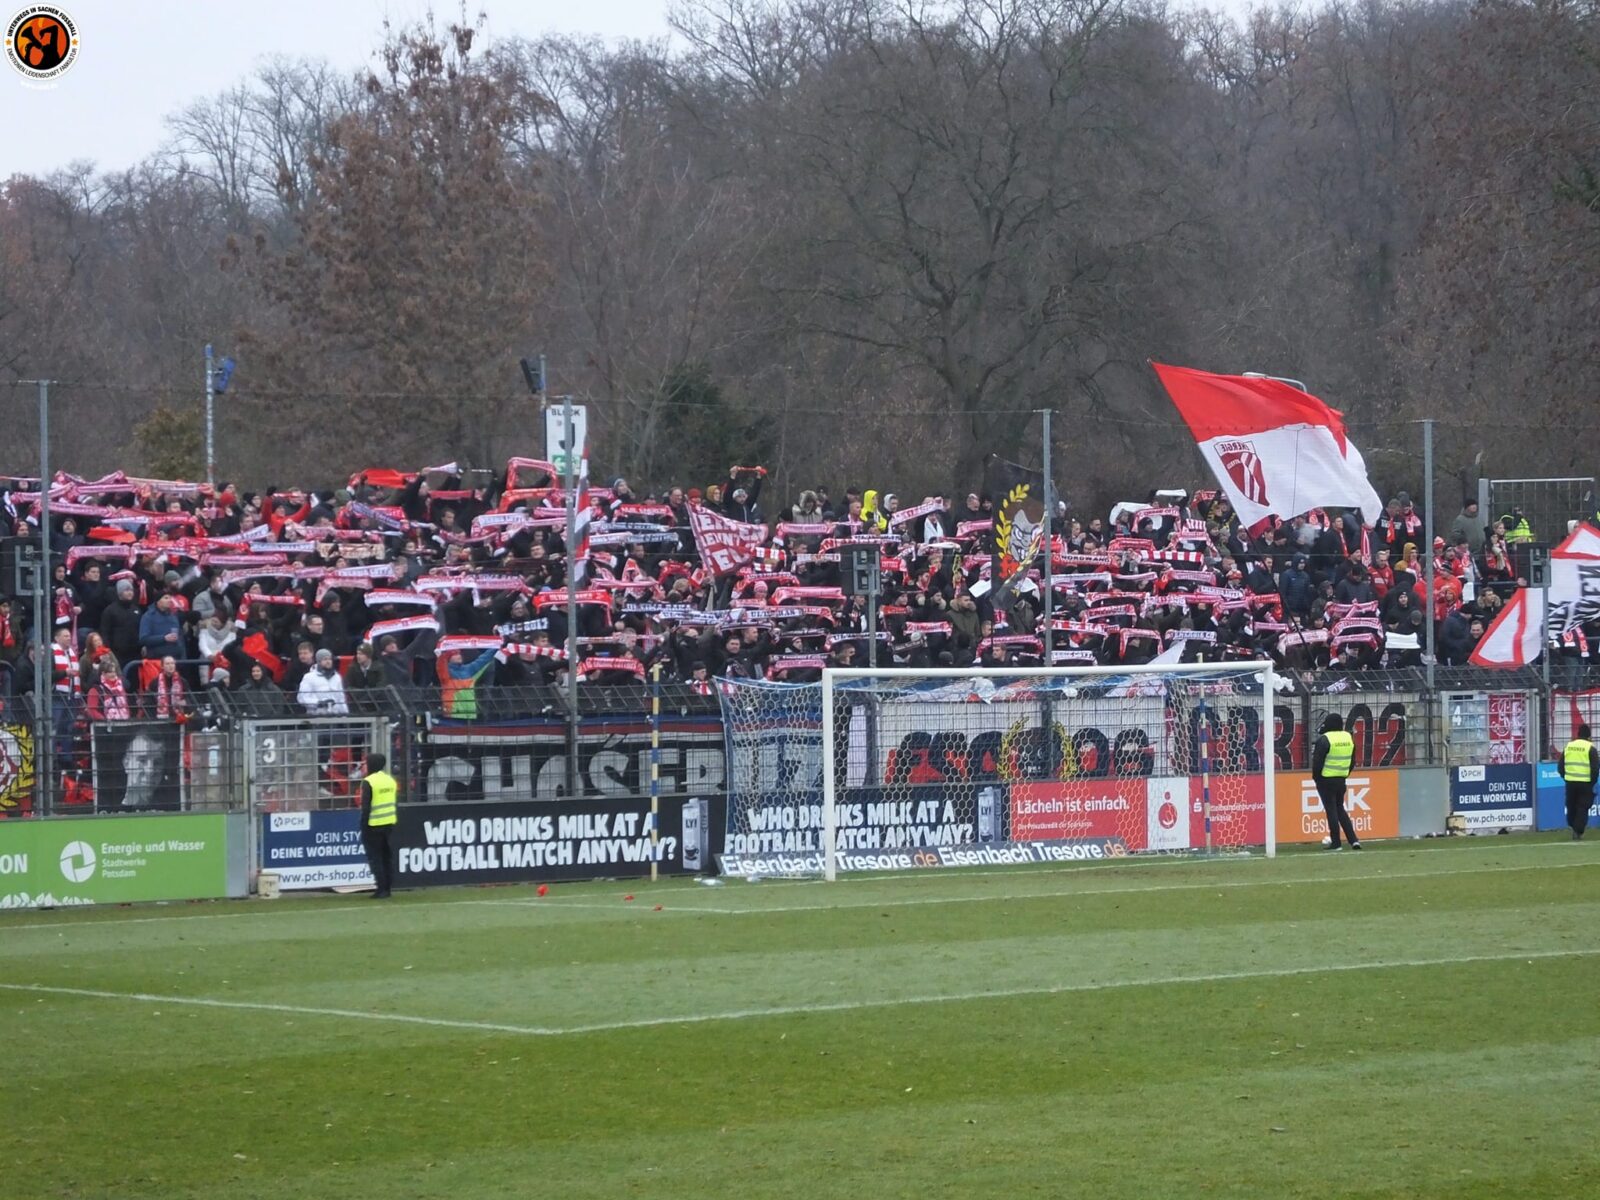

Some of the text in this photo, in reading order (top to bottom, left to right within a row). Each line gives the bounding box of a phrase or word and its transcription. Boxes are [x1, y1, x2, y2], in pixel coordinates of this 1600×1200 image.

[262, 738, 276, 763] 3
[1489, 781, 1527, 792] DEIN STYLE
[1017, 794, 1130, 815] Lächeln ist einfach.
[1459, 793, 1527, 804] DEINE WORKWEAR
[284, 817, 305, 826] PCH
[751, 807, 795, 831] WHO
[866, 802, 913, 826] MILK
[915, 801, 939, 823] AT
[942, 800, 955, 823] A
[423, 819, 476, 845] WHO
[480, 815, 554, 843] DRINKS
[558, 813, 609, 839] MILK
[612, 812, 639, 837] AT
[315, 830, 362, 844] DEIN STY
[724, 831, 816, 855] FOOTBALL
[884, 823, 974, 849] ANYWAY?
[101, 840, 205, 856] Energie und Wasser
[271, 844, 367, 859] DEINE WORKWEA
[399, 836, 677, 873] FOOTBALL MATCH ANYWAY?
[938, 842, 1034, 866] Eisenbach
[101, 857, 147, 868] Stadtwerke
[101, 869, 137, 879] Potsdam
[279, 867, 372, 884] ww.pch-shop.de
